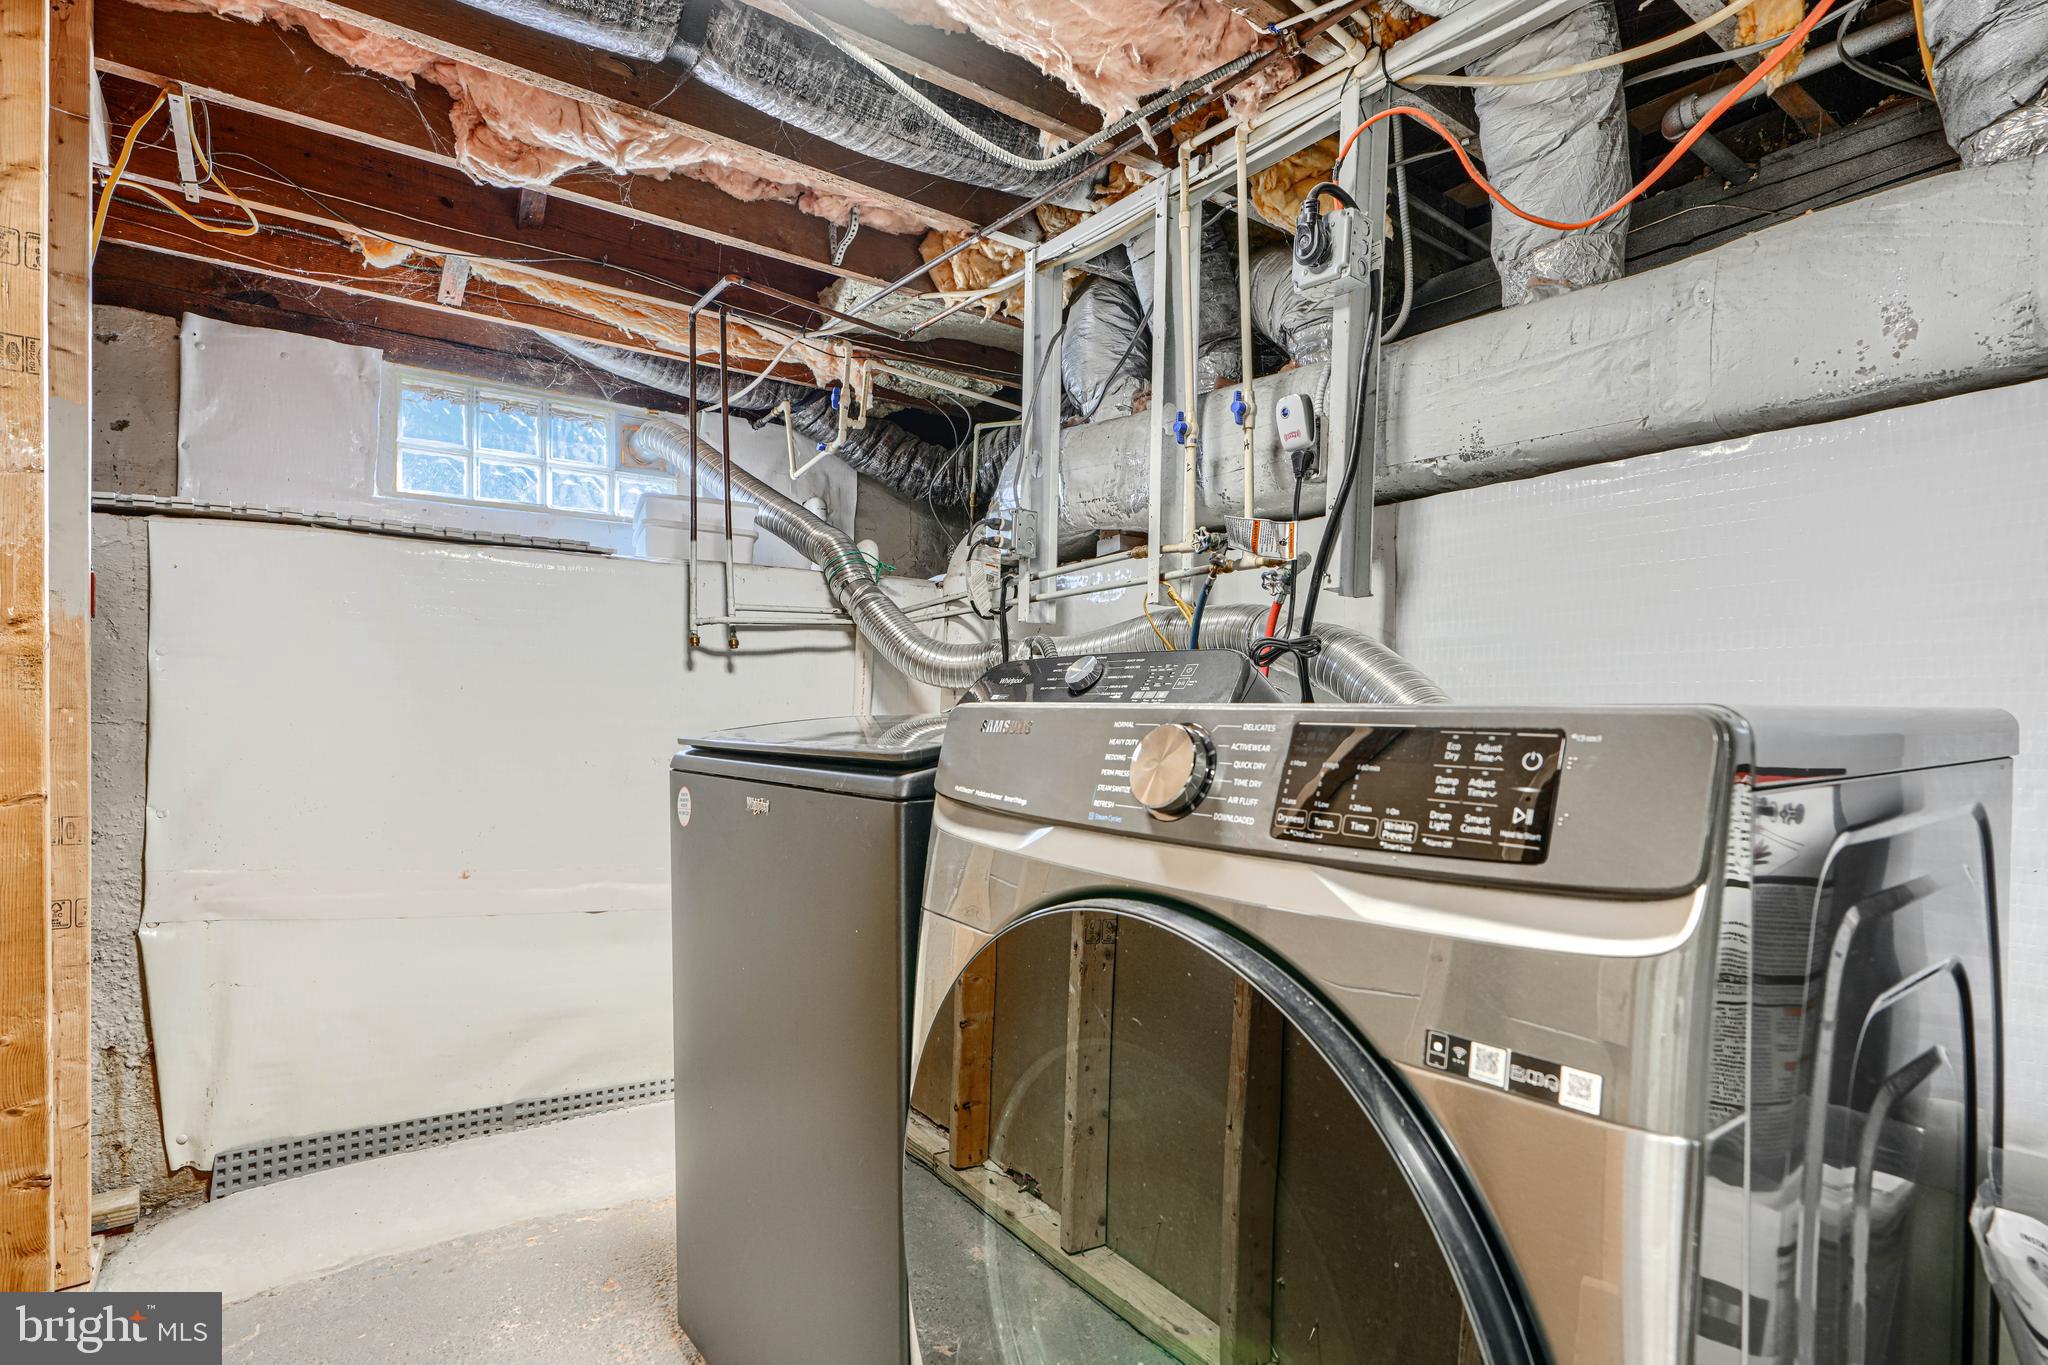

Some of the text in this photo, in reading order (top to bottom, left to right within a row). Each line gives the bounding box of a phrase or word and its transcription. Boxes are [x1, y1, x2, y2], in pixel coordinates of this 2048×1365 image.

[980, 719, 1032, 735] SAMSUNG
[1243, 723, 1276, 732] DELICATES
[1230, 743, 1271, 752] ACTIVEWEAR
[1446, 742, 1462, 751] Eco
[1474, 743, 1503, 754] Adjust
[1444, 751, 1460, 761] Dry
[1474, 753, 1495, 762] Time
[1233, 760, 1266, 770] QUICK DRY
[1233, 778, 1262, 788] TIME DRY
[1435, 775, 1460, 786] Damp
[1468, 778, 1497, 789] Adjust
[1434, 785, 1456, 795] Alert
[1467, 787, 1488, 798] Time
[1093, 799, 1115, 808] REFRESH
[1227, 796, 1259, 806] AIR FLUFF
[1213, 812, 1255, 825] DOWNLOADED
[1277, 812, 1305, 824] Dryness
[1429, 810, 1453, 821] Drum
[1464, 813, 1491, 825] Smart
[1314, 816, 1335, 829] Temp.
[1351, 821, 1370, 832] Time
[1383, 821, 1414, 833] Wrinkle
[1428, 820, 1451, 832] Light
[1460, 823, 1492, 836] Control
[1381, 830, 1413, 842] Prevent
